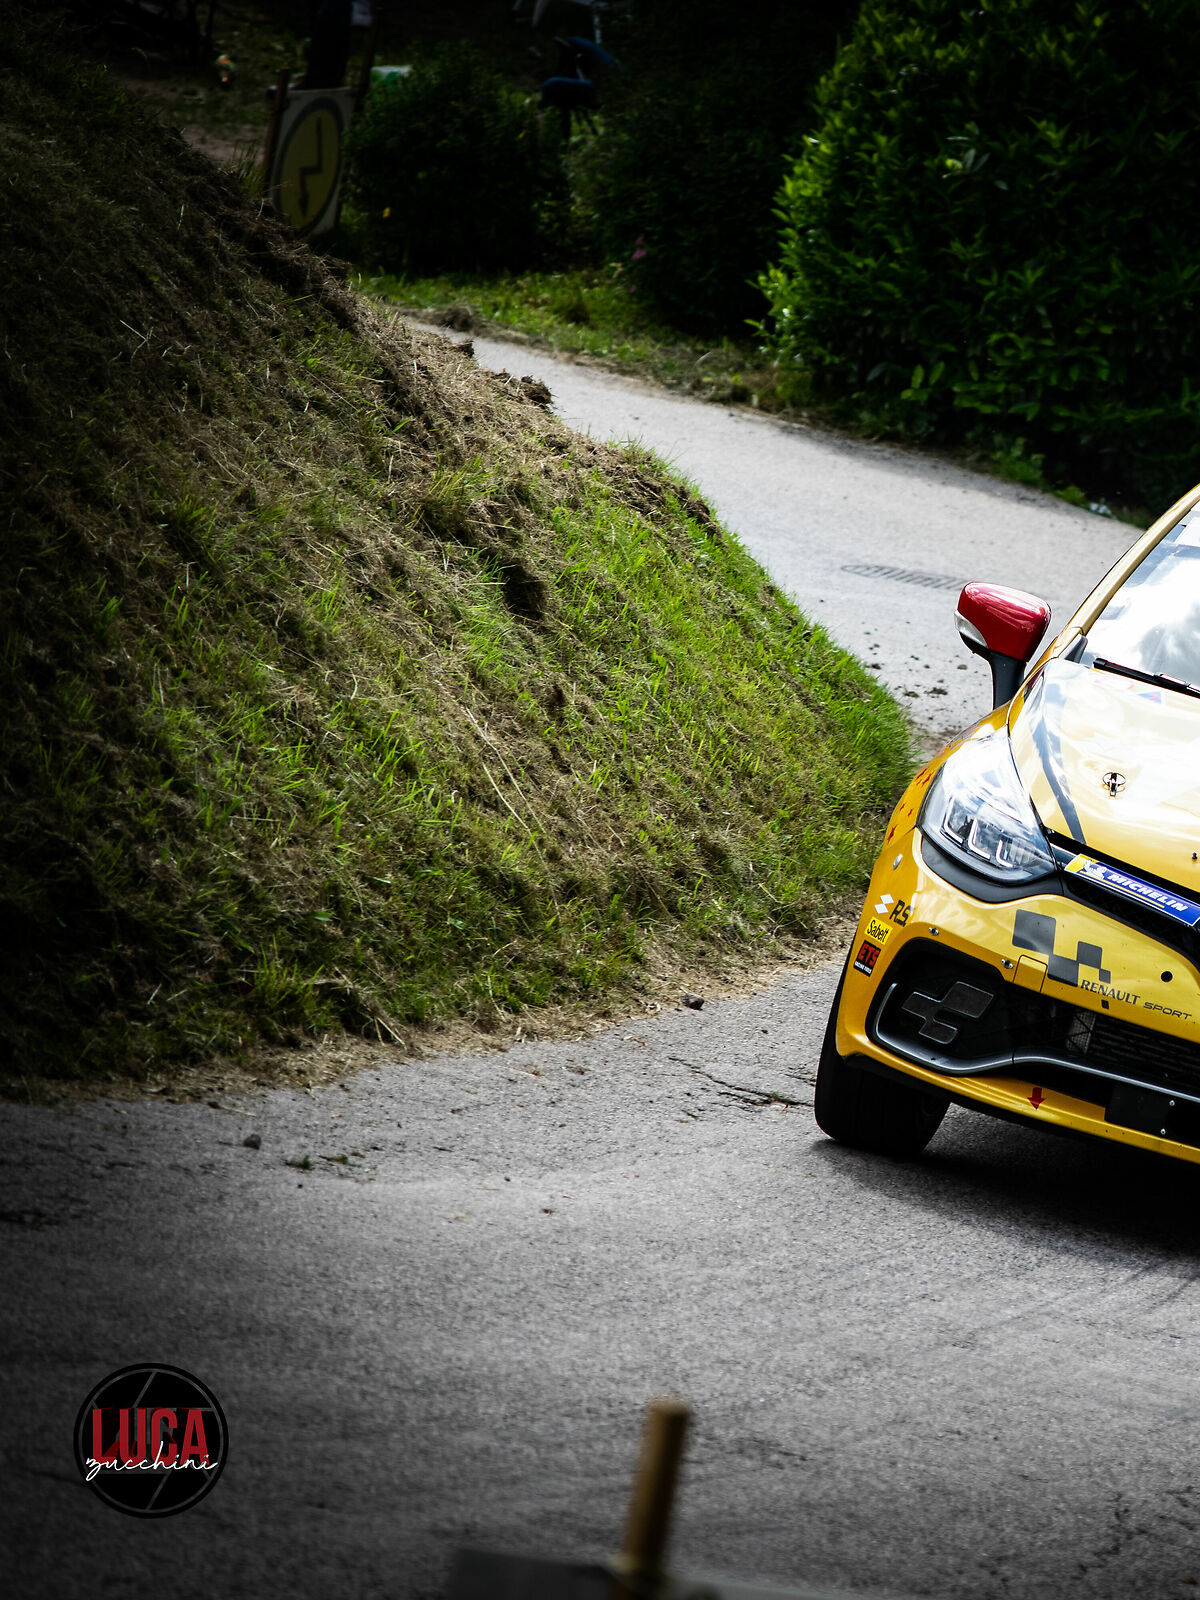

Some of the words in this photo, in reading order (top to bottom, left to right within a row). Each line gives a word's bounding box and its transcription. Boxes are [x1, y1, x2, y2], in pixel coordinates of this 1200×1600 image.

[1106, 871, 1189, 912] MICHELIN
[866, 919, 890, 943] Sabelt
[858, 941, 881, 967] ETS
[1080, 979, 1141, 1005] RENAULT
[1143, 1001, 1193, 1020] SPORT
